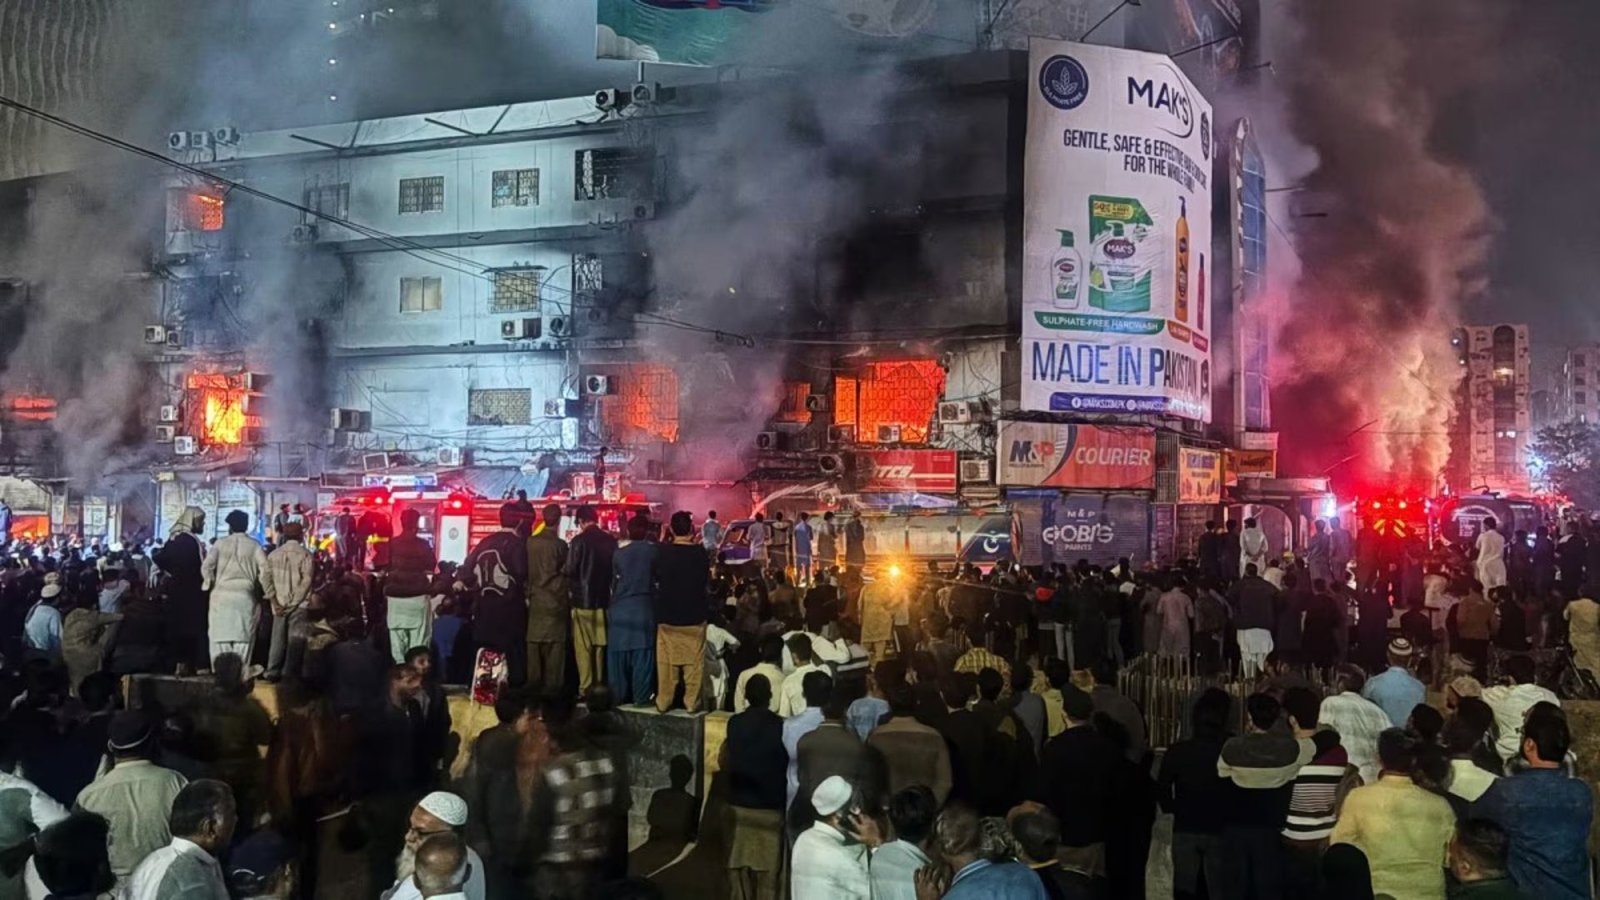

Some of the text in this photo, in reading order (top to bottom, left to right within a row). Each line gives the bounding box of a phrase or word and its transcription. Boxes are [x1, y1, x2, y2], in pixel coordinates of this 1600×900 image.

[1128, 77, 1188, 125] MAK'S
[1063, 129, 1111, 152] GENTLE,
[1114, 134, 1142, 154] SAFE
[1144, 138, 1152, 155] &
[1124, 155, 1146, 173] FOR
[1148, 157, 1166, 176] THE
[1033, 341, 1110, 385] MADE
[1118, 346, 1142, 386] IN
[1076, 446, 1151, 466] COURIER
